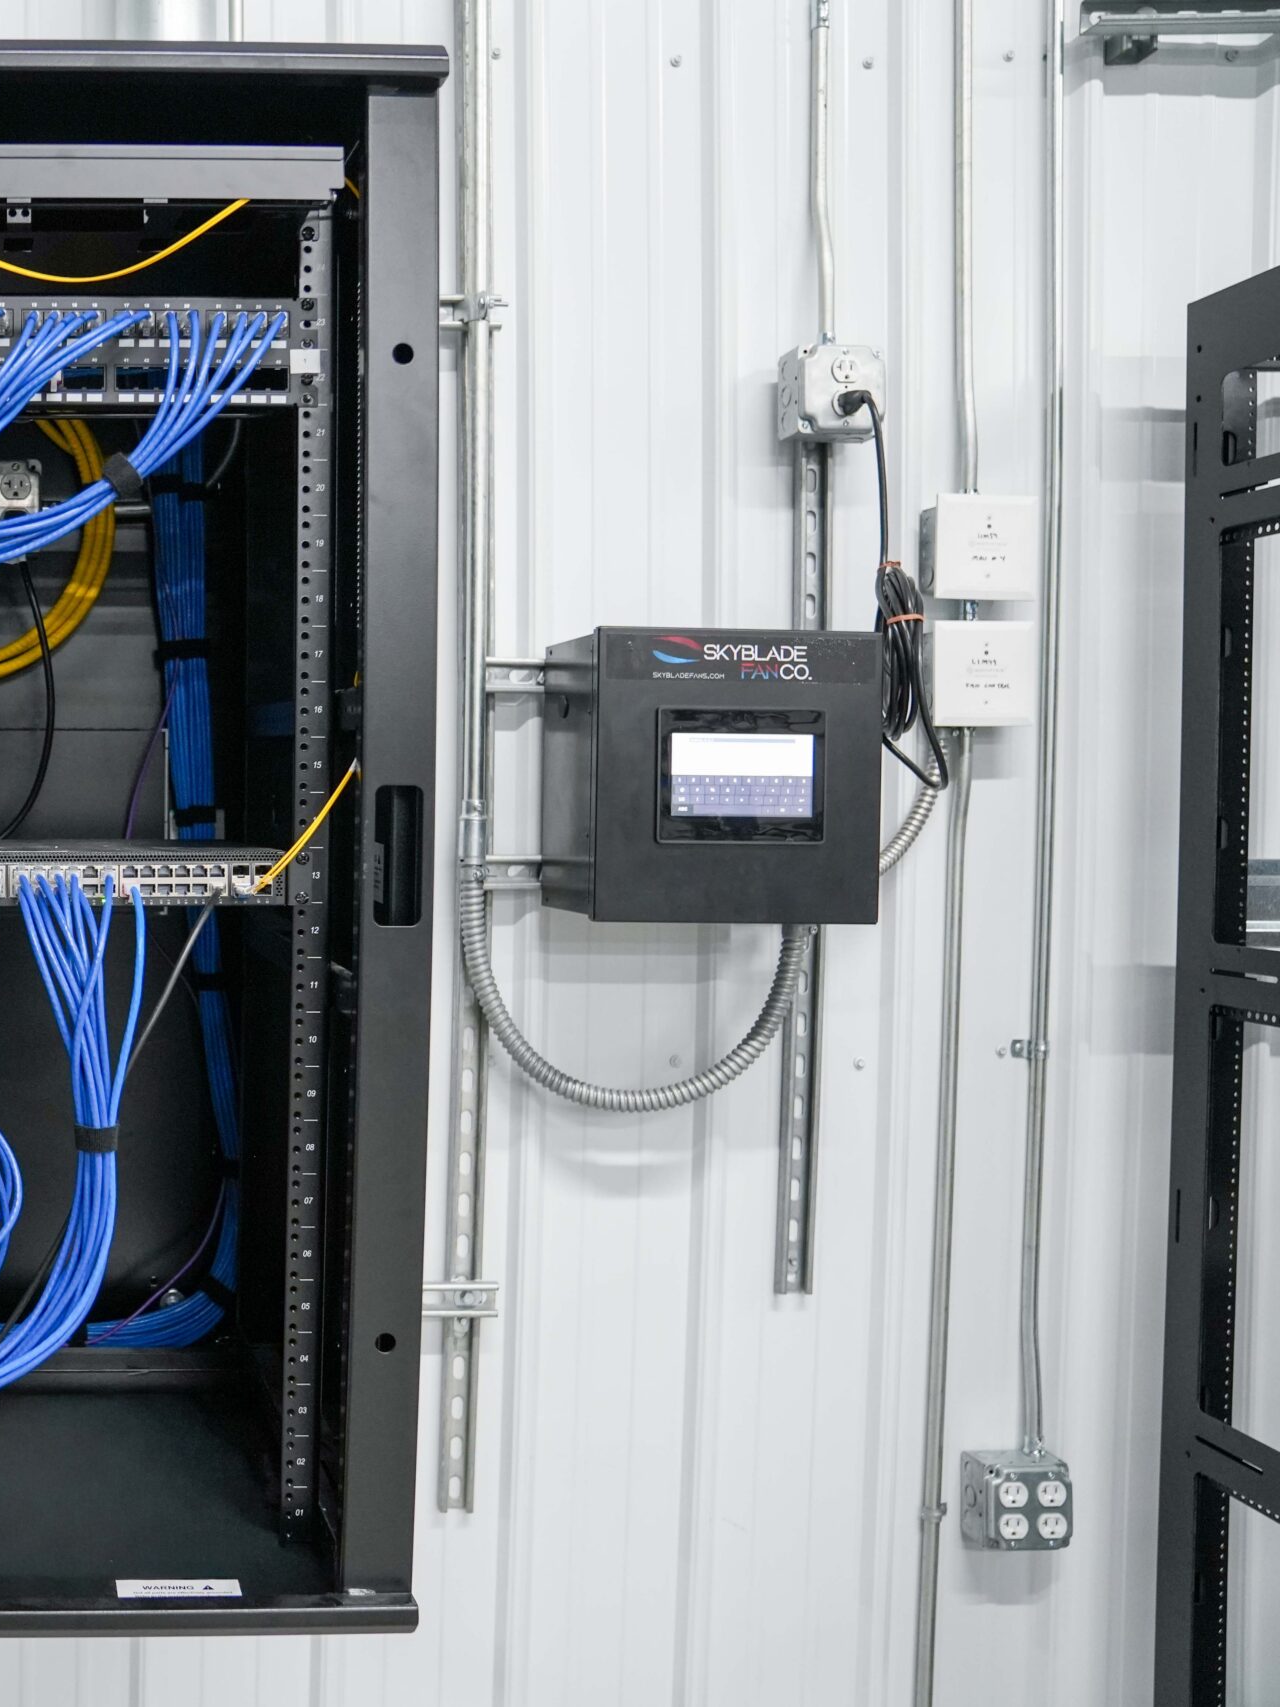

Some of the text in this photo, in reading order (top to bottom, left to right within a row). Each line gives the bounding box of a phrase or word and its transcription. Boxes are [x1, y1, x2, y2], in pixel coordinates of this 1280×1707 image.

[316, 428, 325, 436] 21
[315, 484, 325, 492] 20
[704, 644, 808, 662] SKYBLADE
[652, 672, 725, 680] SKYBLADEFANS.COM
[314, 706, 322, 714] 16
[304, 1196, 314, 1204] 07
